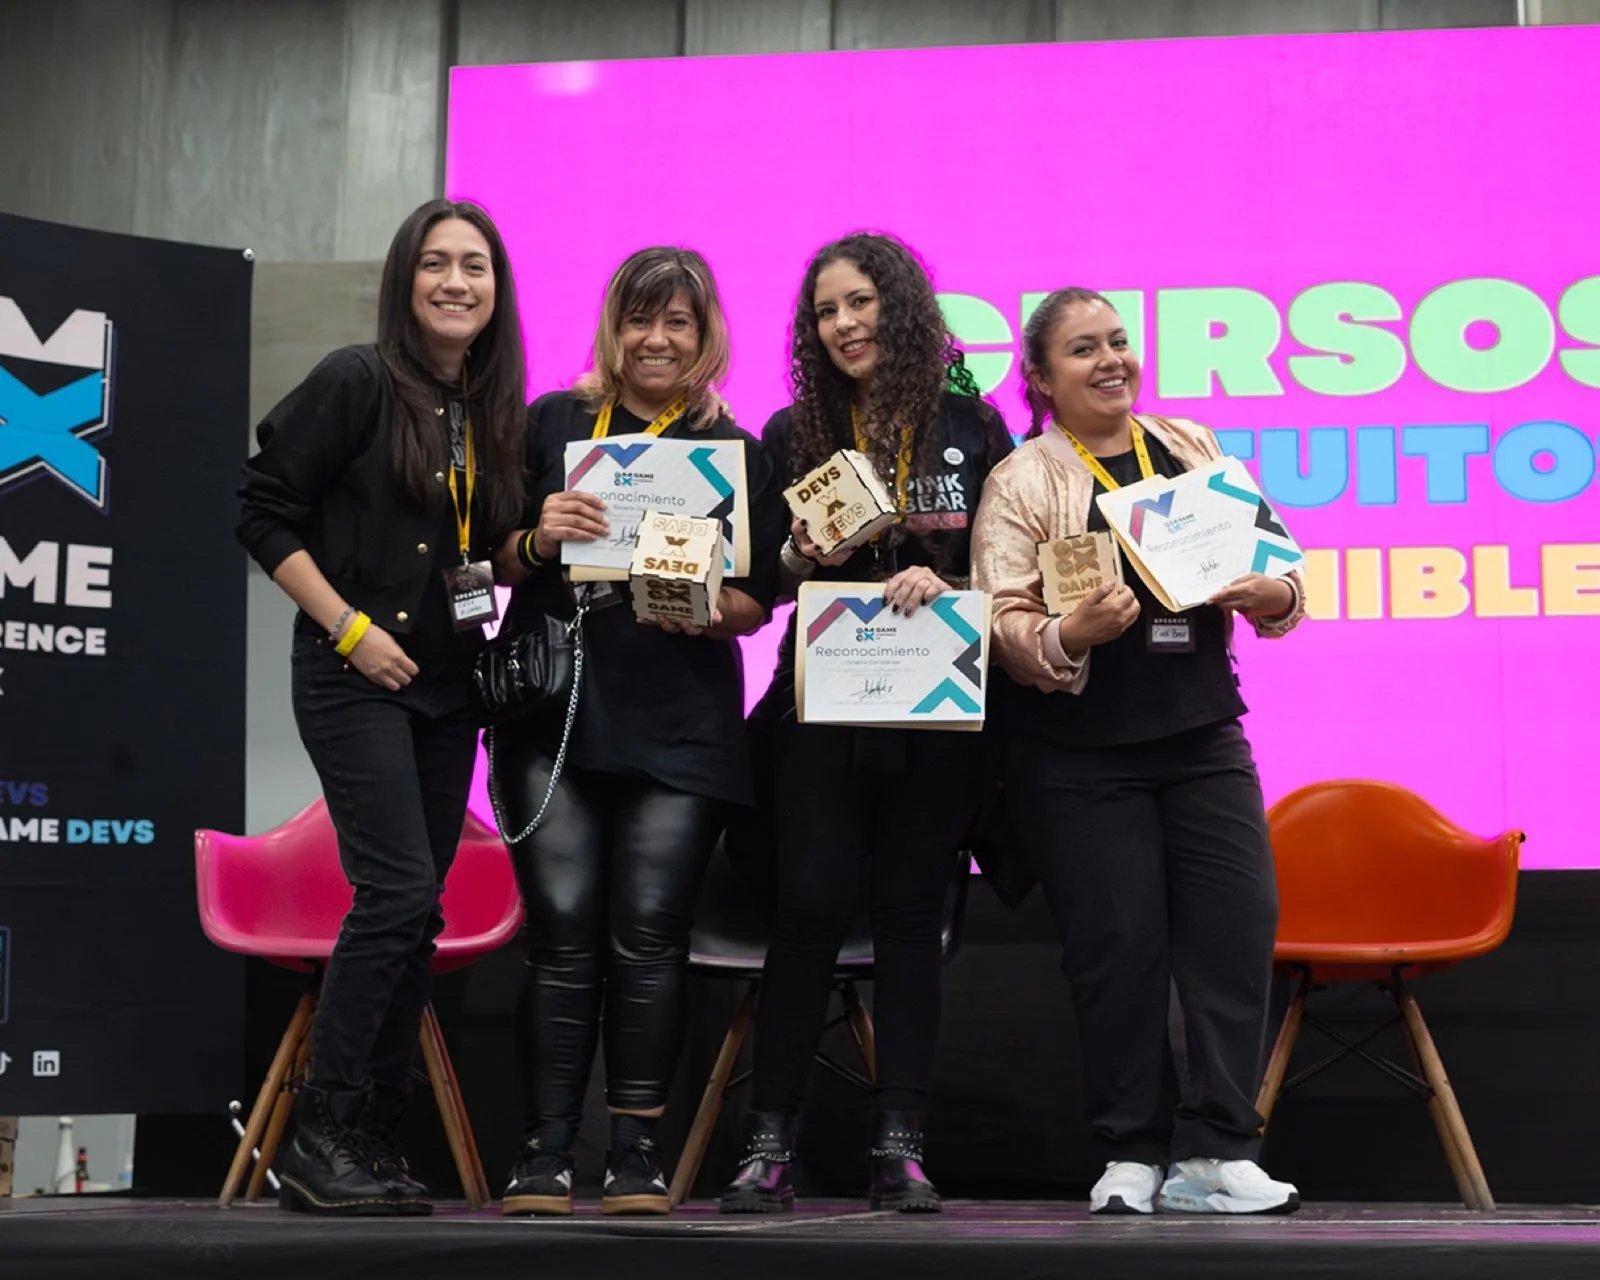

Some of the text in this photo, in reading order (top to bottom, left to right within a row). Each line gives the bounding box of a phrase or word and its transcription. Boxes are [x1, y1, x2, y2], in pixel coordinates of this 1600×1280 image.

[797, 466, 841, 504] DEVS
[594, 491, 686, 506] onocimiento
[652, 517, 708, 536] DEVS
[820, 502, 867, 541] DEVS
[643, 557, 699, 575] DEVS
[0, 620, 107, 656] ENCE
[815, 646, 931, 657] Reconocimiento
[0, 780, 48, 807] VS
[66, 818, 155, 844] DEVS
